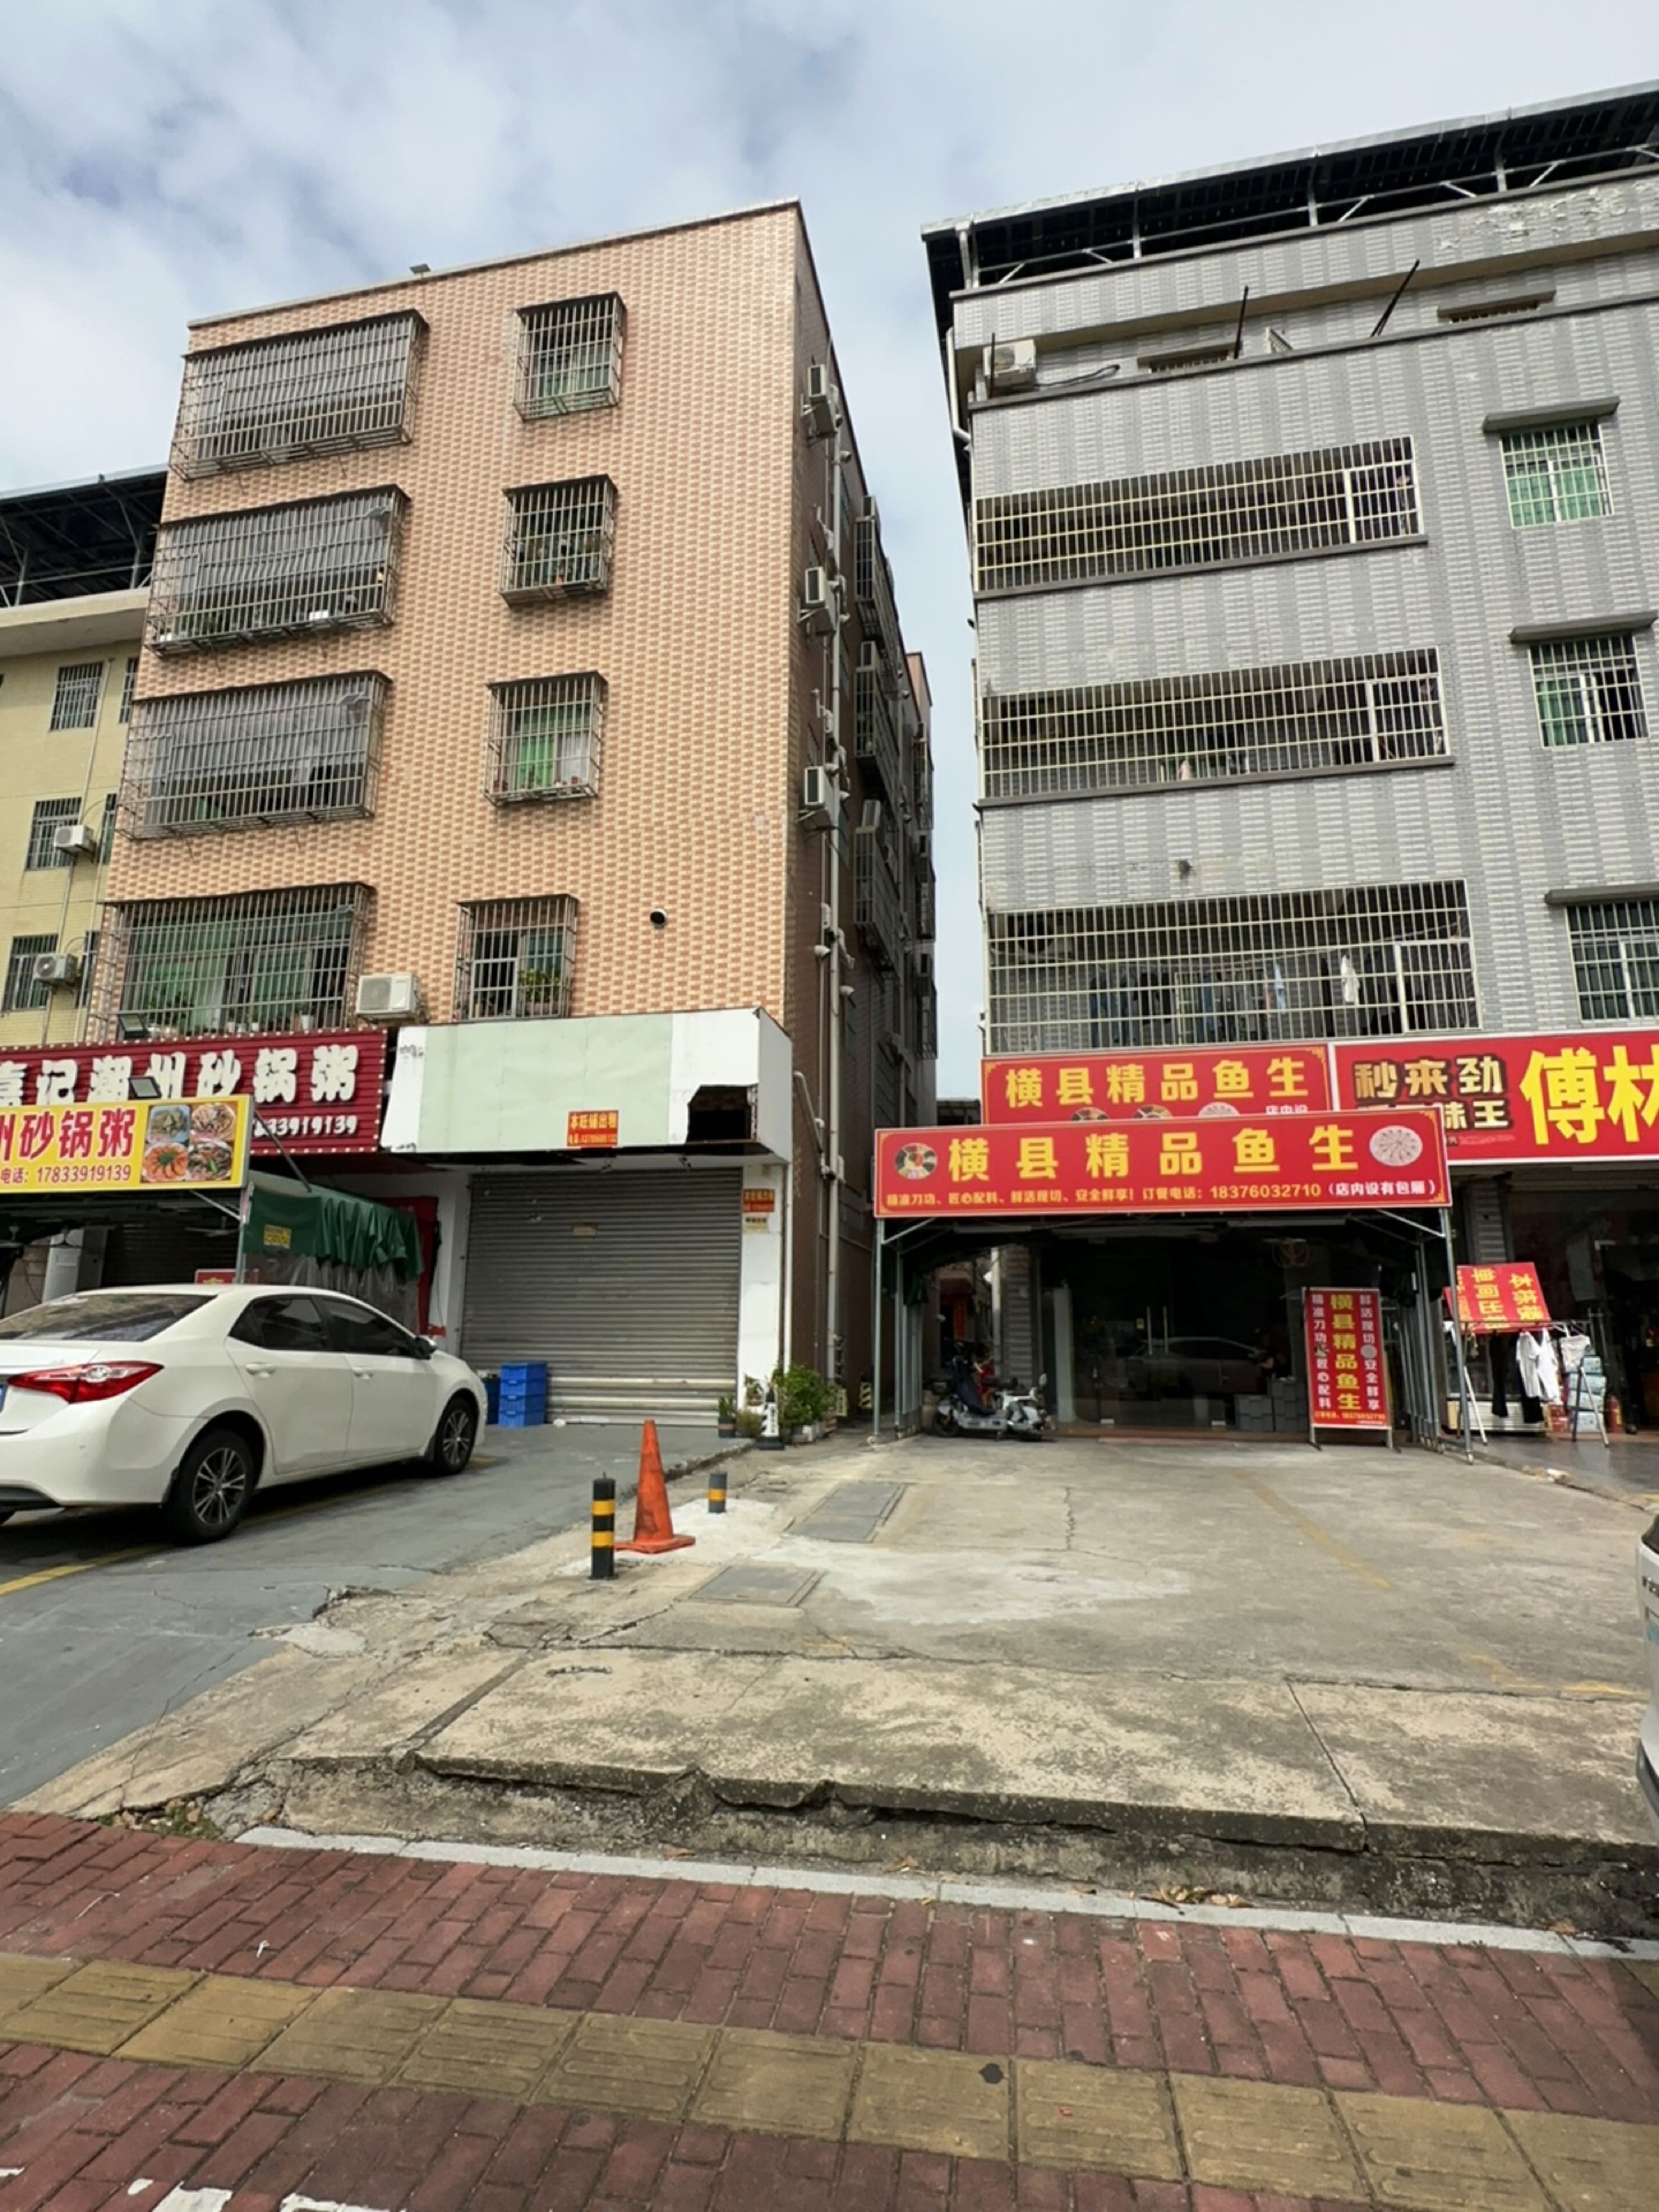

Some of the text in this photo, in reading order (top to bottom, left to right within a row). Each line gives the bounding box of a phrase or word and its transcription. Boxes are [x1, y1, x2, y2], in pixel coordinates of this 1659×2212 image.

[1005, 1057, 1309, 1108] 横县精品鱼生
[1354, 1056, 1503, 1099] 秒来劲
[949, 1125, 1359, 1182] 横县精品鱼生
[1330, 1294, 1361, 1410] 横县精品鱼生
